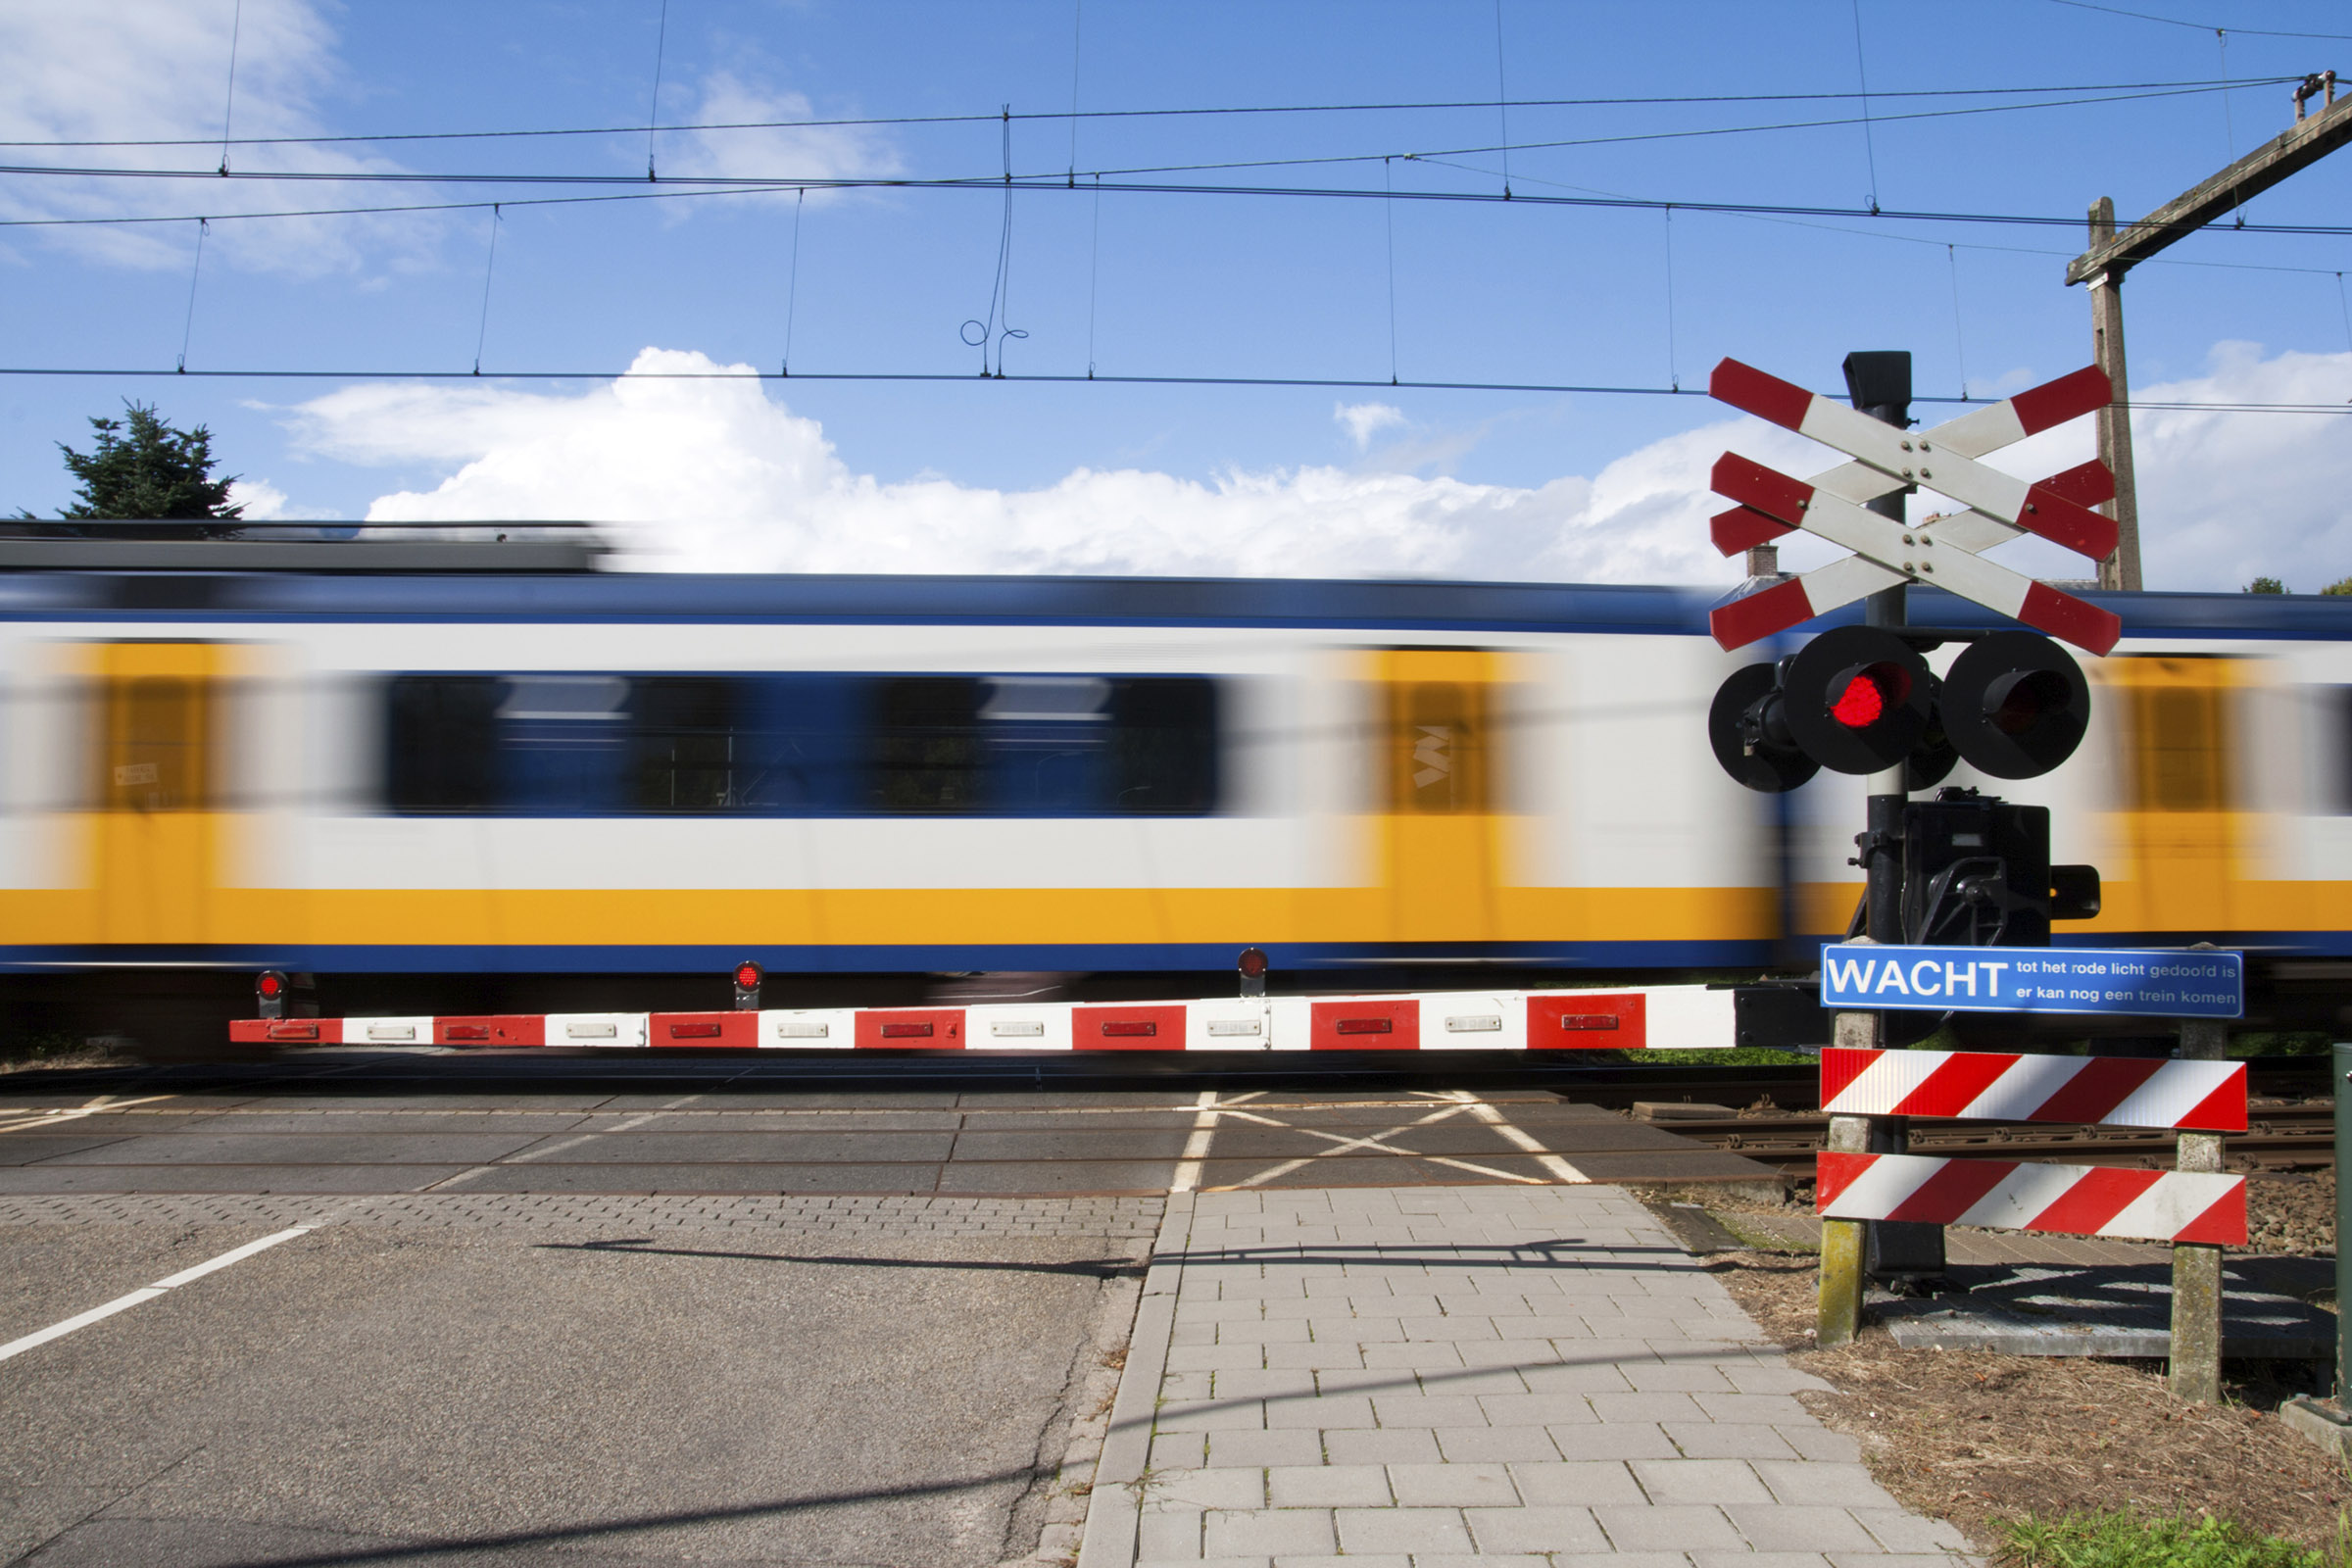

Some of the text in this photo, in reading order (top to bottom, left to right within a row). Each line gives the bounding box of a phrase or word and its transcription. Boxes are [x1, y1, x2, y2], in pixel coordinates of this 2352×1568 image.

[1827, 959, 2008, 997] WACHT
[2016, 959, 2235, 978] tot het rode licht gedoofd is
[2016, 986, 2236, 1004] er kan nog een trein komen
